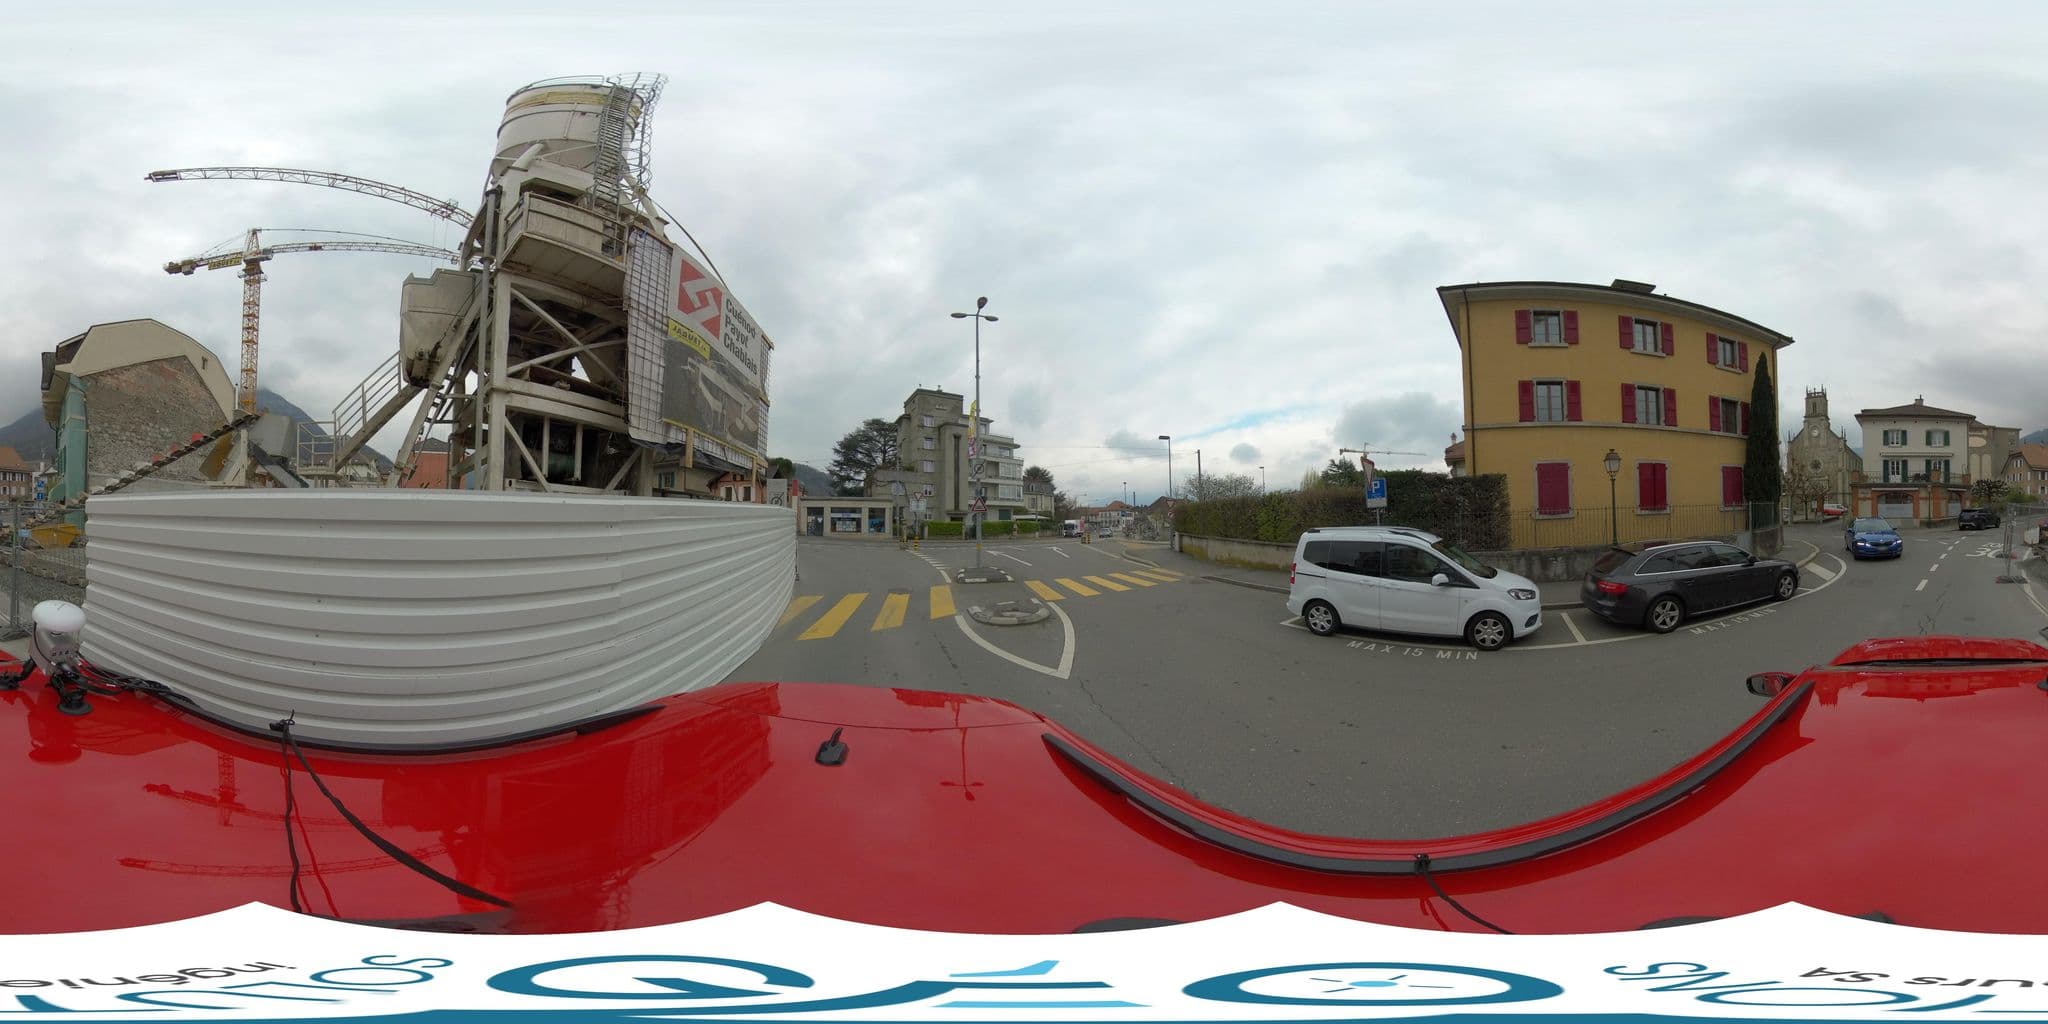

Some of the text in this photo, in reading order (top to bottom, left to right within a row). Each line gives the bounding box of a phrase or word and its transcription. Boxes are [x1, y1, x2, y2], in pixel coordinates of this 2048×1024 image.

[725, 314, 749, 348] Payot
[726, 298, 756, 339] Cuénod
[724, 333, 758, 375] Chablais
[1372, 480, 1380, 494] P
[1690, 621, 1731, 635] MAX
[1731, 615, 1750, 624] 15
[1346, 640, 1479, 661] MAX 15 MIN
